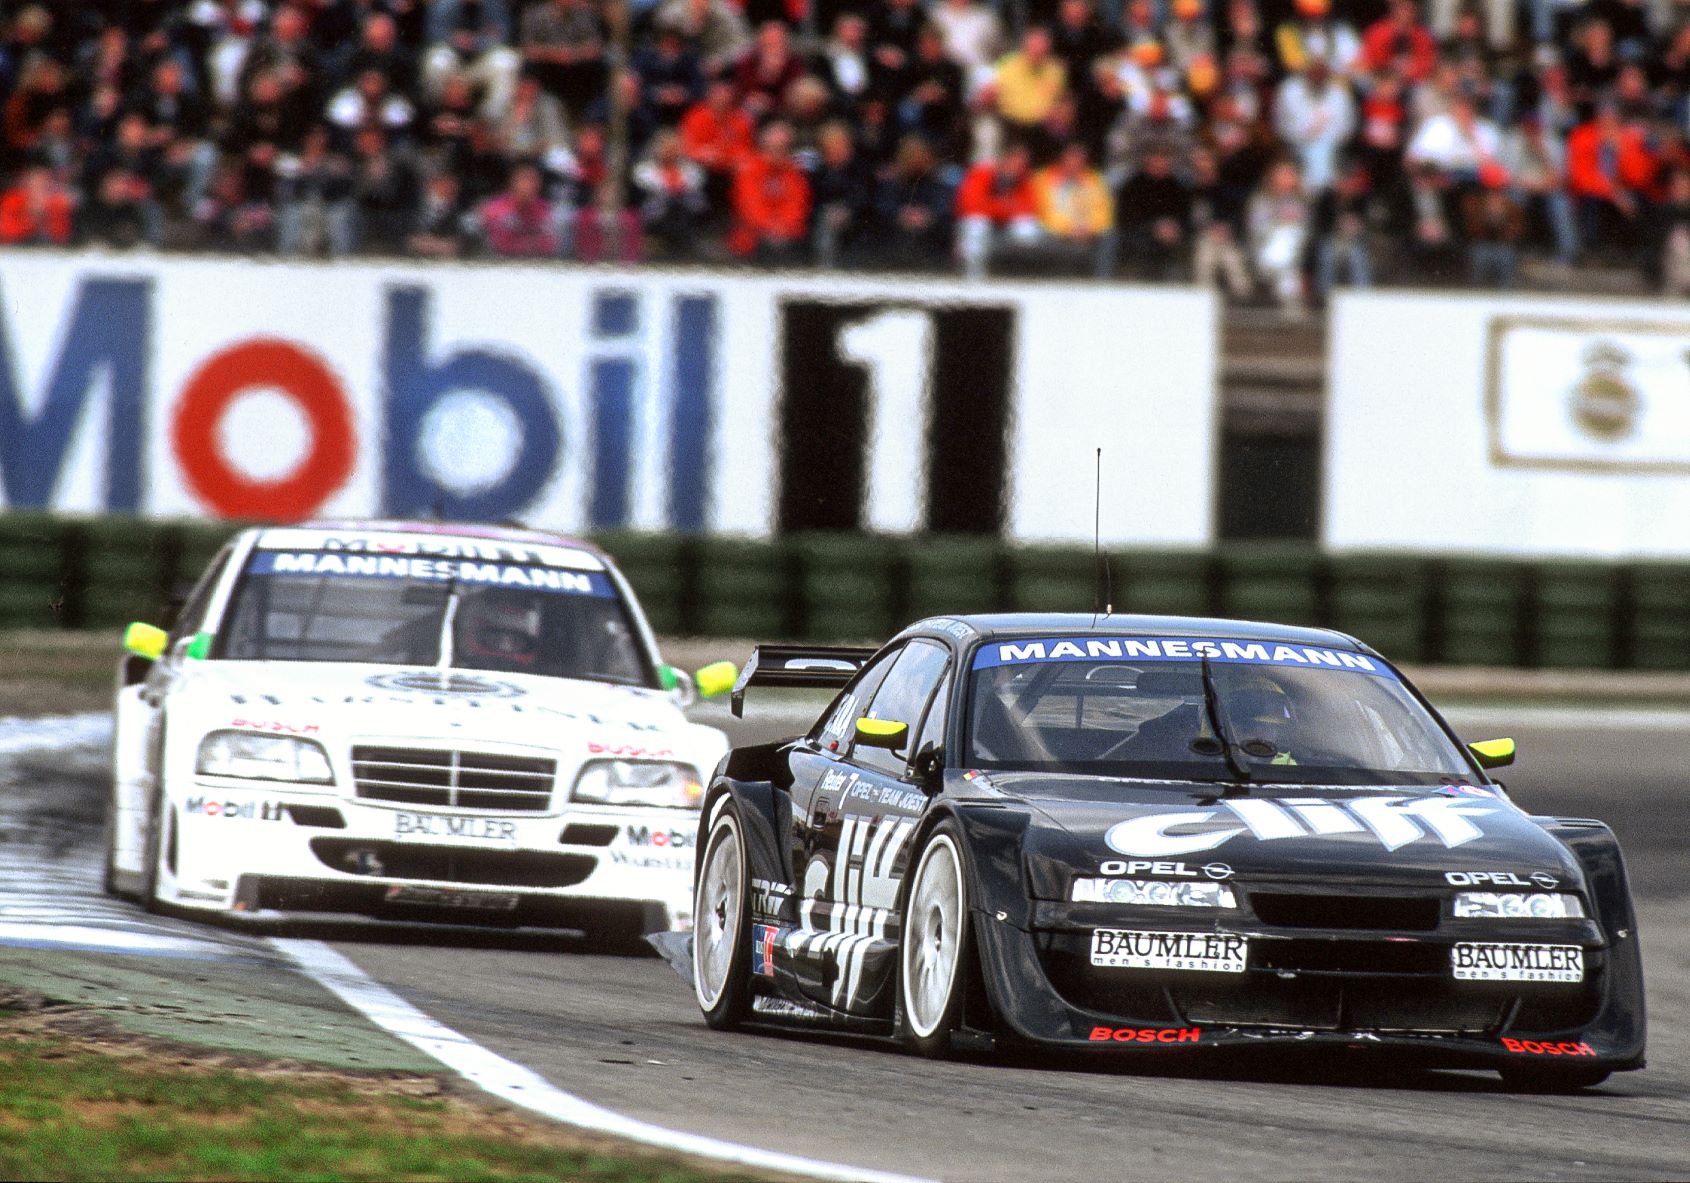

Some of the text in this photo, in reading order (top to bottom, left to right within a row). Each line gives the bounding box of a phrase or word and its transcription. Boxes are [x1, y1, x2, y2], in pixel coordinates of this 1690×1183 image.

[0, 275, 933, 532] Mobil 1
[273, 553, 592, 592] MANNESMANN
[999, 640, 1376, 671] MANNESMANN
[879, 787, 903, 807] TEAM
[899, 792, 930, 813] JOEST
[1104, 798, 1503, 857] cliff
[1100, 861, 1198, 876] OPEL
[1444, 872, 1532, 887] OPEL
[1165, 959, 1243, 971] fashion
[1089, 1026, 1200, 1043] BOSCH
[1502, 1037, 1597, 1057] BOSCH
